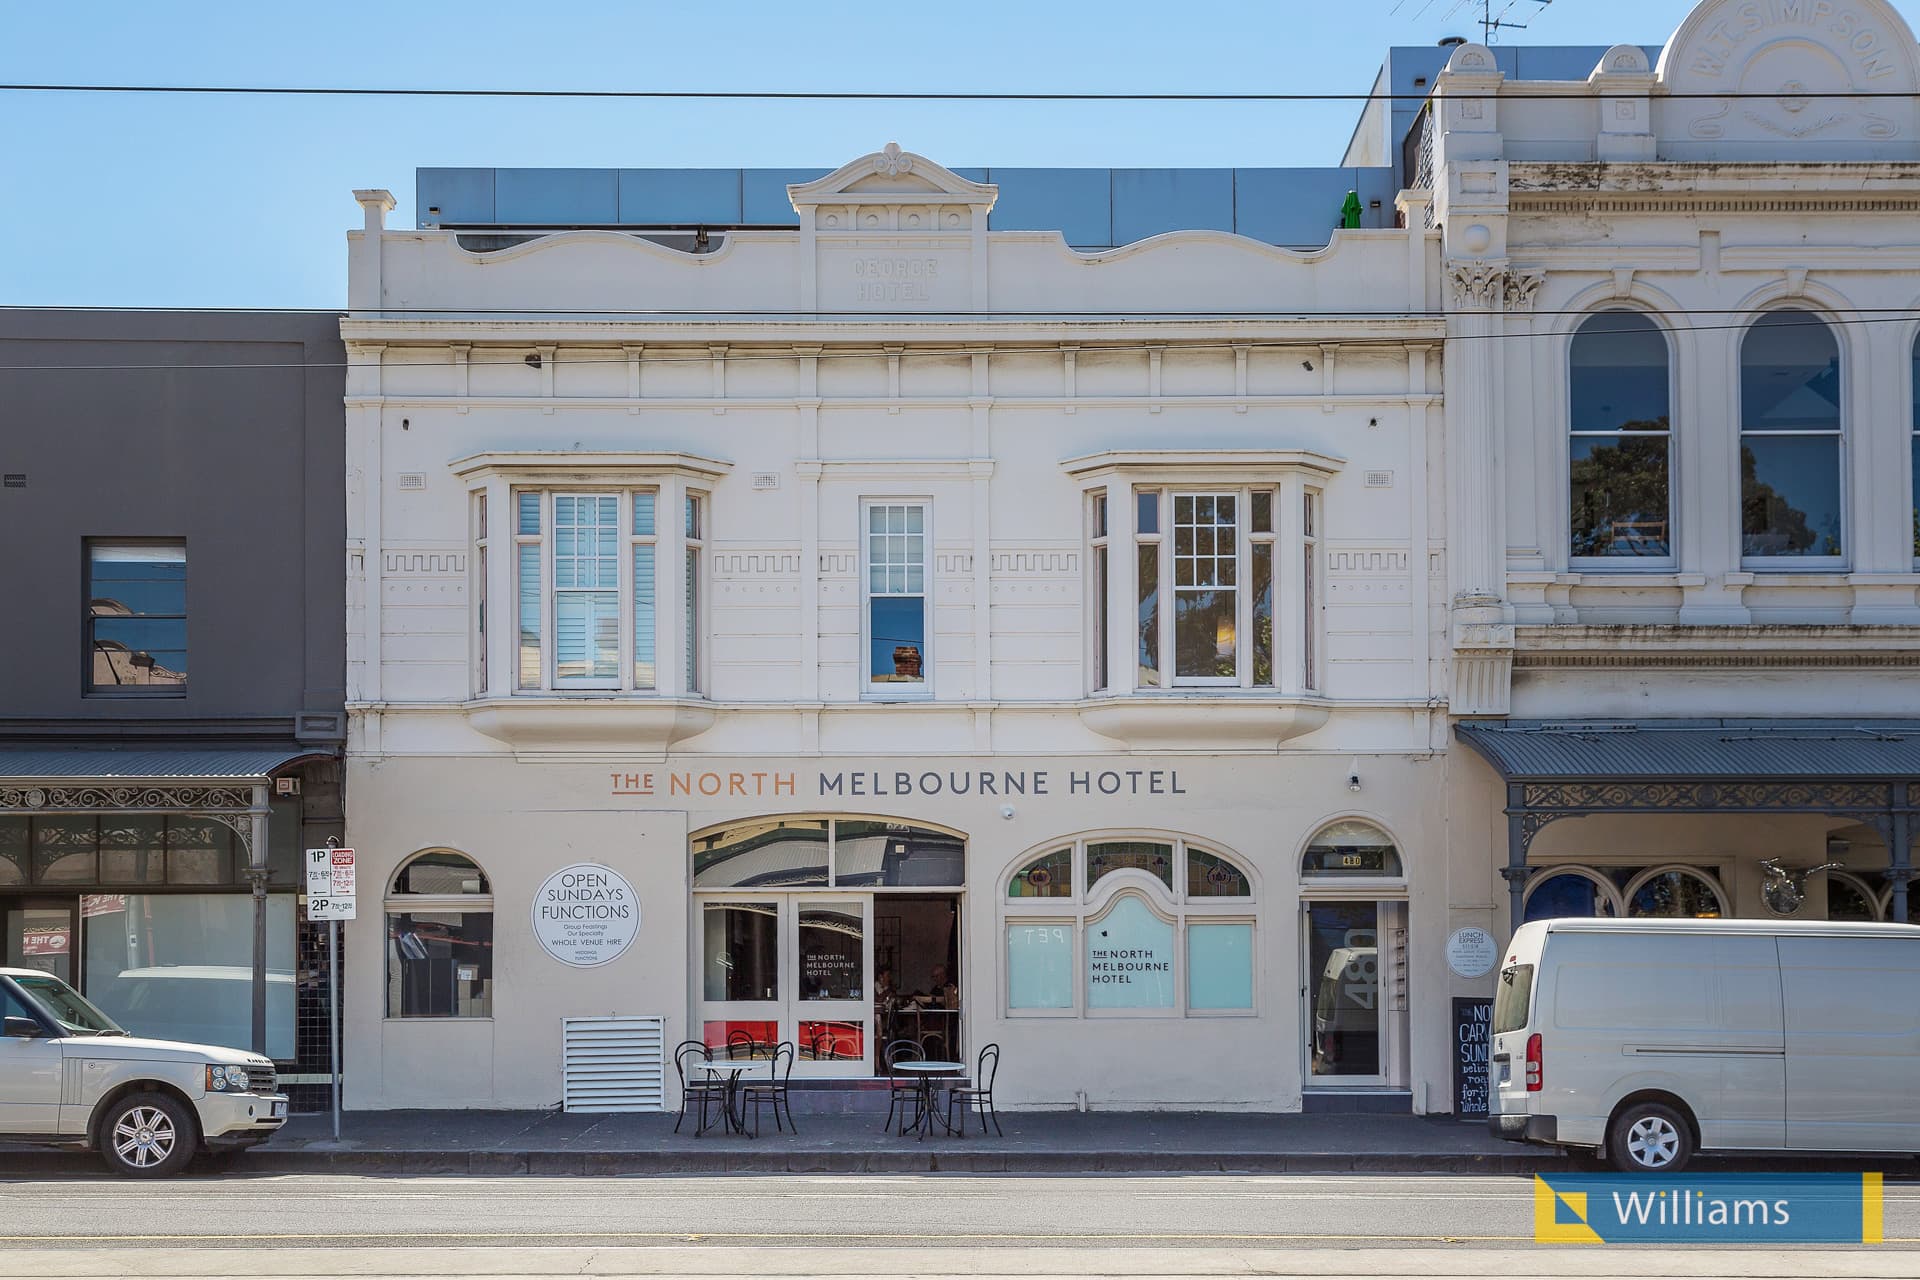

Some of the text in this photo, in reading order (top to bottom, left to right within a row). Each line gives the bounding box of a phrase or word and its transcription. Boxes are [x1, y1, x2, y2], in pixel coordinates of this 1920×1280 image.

[856, 281, 930, 301] HOTEL
[610, 770, 1186, 796] THE NORTH MELBOURNE HOTEL
[311, 851, 326, 863] 1P
[561, 873, 607, 888] OPEN
[547, 888, 624, 901] SUNDAYS
[312, 900, 329, 911] 2P
[542, 904, 630, 920] FUNCTIONS
[580, 938, 604, 946] VENUE
[606, 938, 623, 946] HIRE
[1110, 950, 1153, 959] NORTH
[1092, 962, 1169, 972] MELBOURNE
[1092, 975, 1132, 984] HOTEL
[1473, 1004, 1493, 1022] NO
